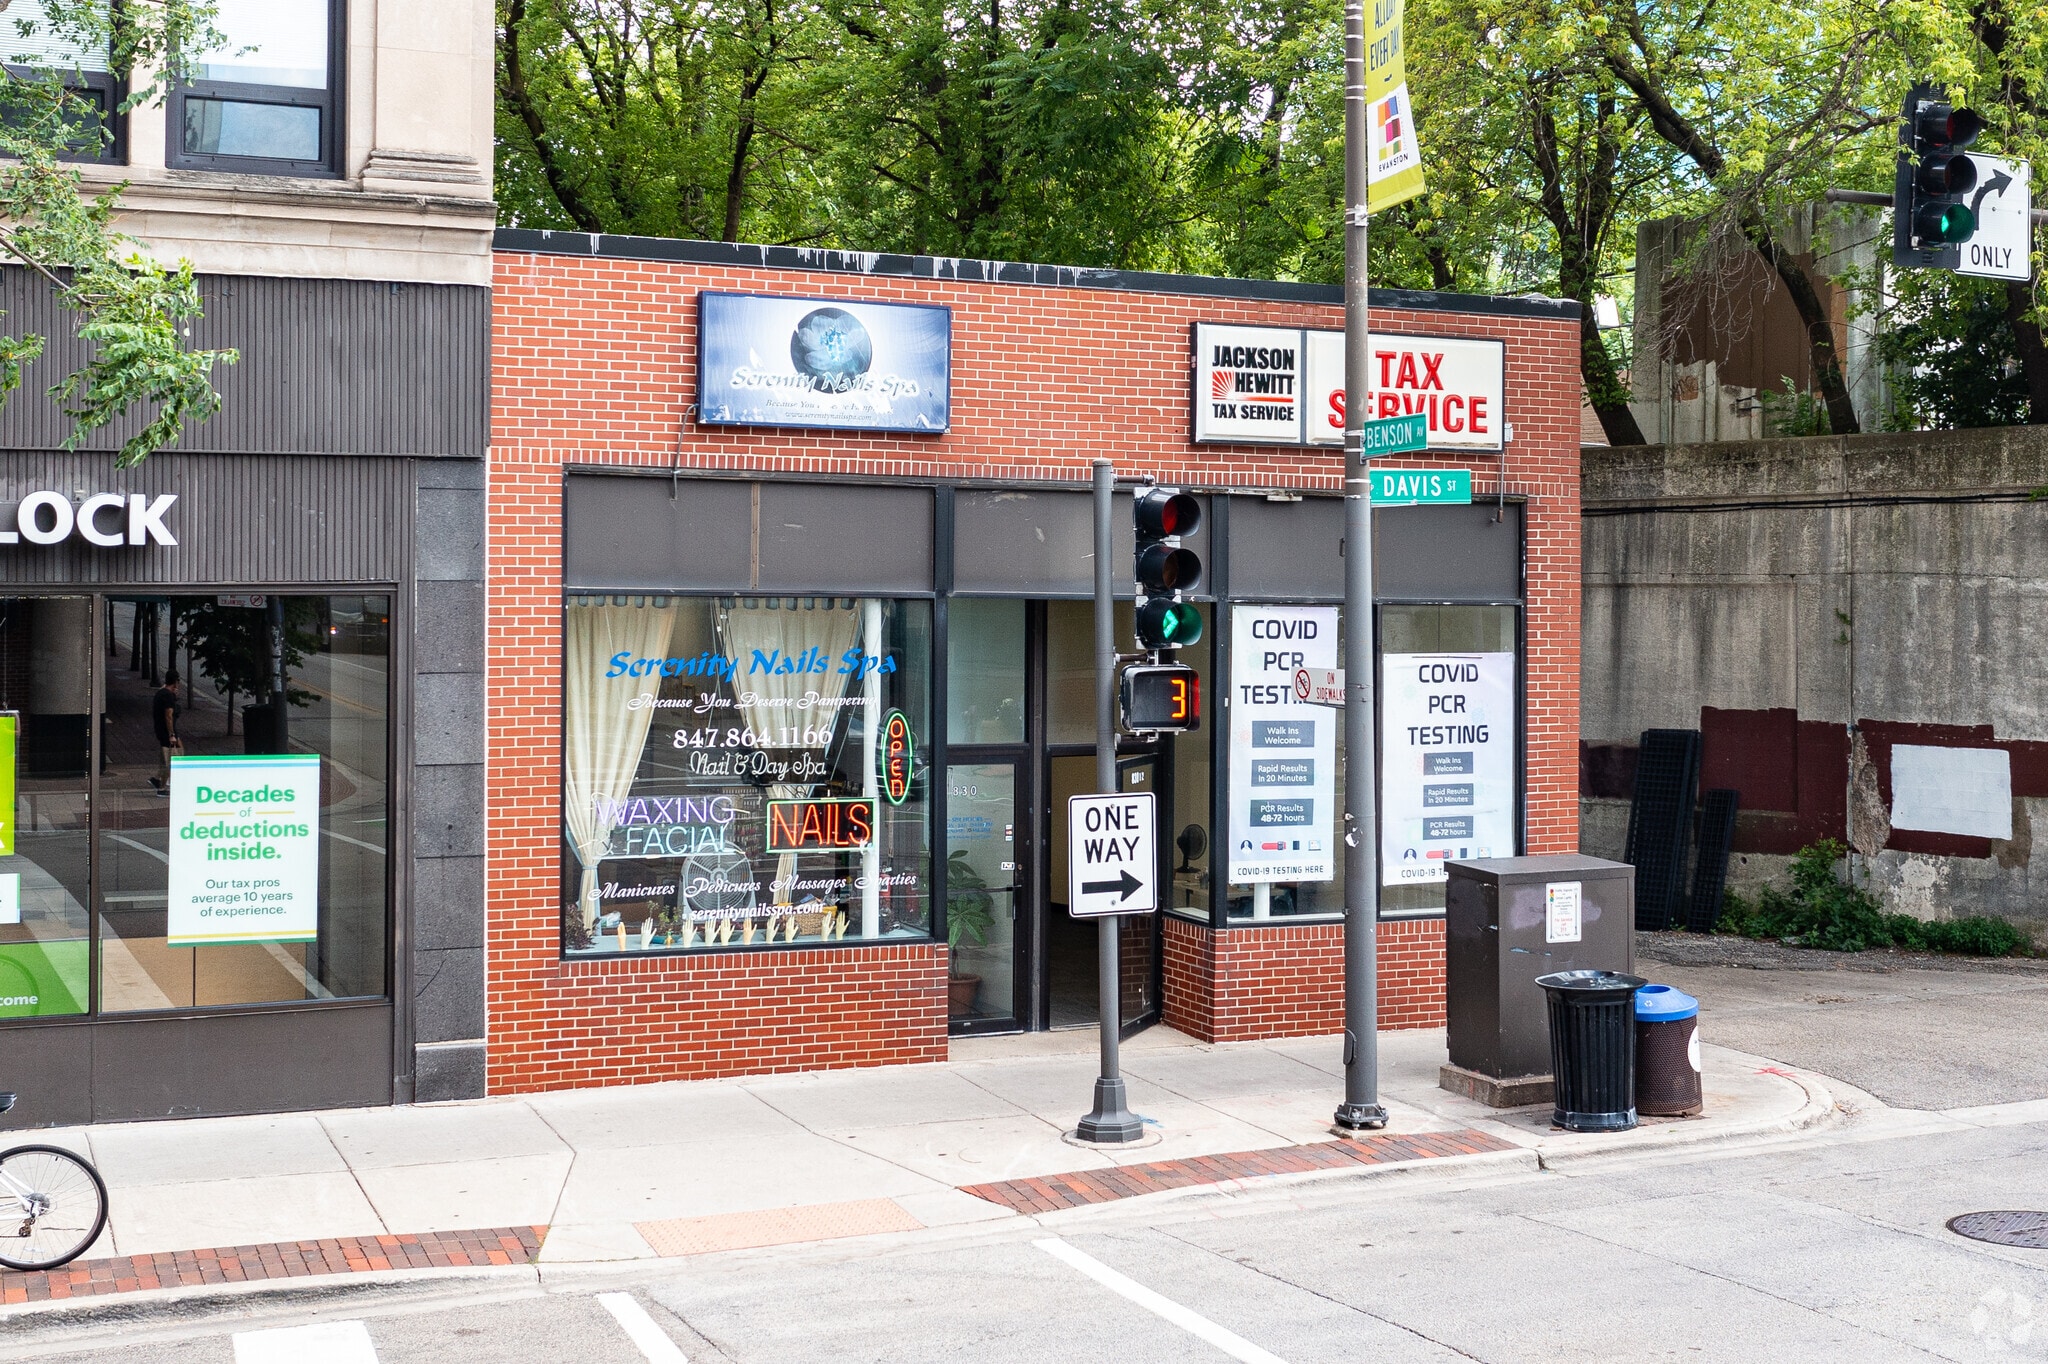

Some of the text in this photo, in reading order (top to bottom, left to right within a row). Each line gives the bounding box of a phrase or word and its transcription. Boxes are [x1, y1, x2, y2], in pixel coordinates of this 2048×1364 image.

[1379, 153, 1409, 172] EVANSTON
[1970, 244, 2012, 268] ONLY
[1212, 345, 1295, 370] JACKSON
[1375, 350, 1444, 391] TAX
[732, 367, 919, 397] Serenity Nails Spa
[1235, 371, 1295, 395] HEWITT
[1212, 403, 1295, 422] TAX SERVICE
[1328, 389, 1488, 433] SRVICE
[1367, 421, 1424, 449] BENSON AV
[1383, 475, 1457, 498] DAVIS ST
[1252, 619, 1318, 640] COVID
[605, 645, 897, 683] Serenity Nails Spa
[1264, 651, 1304, 671] PCR
[1327, 672, 1335, 685] ON
[1418, 663, 1478, 684] COVID
[627, 690, 880, 713] Because You Deserve Pampering
[1171, 679, 1186, 718] 3
[1240, 685, 1303, 704] TEST
[1428, 694, 1466, 714] PCR
[673, 723, 833, 749] 847.864.1166
[1265, 735, 1302, 745] Welcome
[1267, 726, 1300, 736] Walk Ins
[1407, 724, 1489, 746] TESTING
[690, 750, 827, 779] Nail & Day Spa
[890, 719, 905, 797] OPEN
[1436, 756, 1461, 765] Walk Ins
[1258, 764, 1308, 775] Rapid Results
[1258, 773, 1307, 783] In 20 Minutes
[1433, 764, 1463, 773] Welcome
[196, 784, 296, 804] Decades
[952, 785, 977, 796] 830
[1428, 786, 1469, 797] Rapid Results
[1445, 795, 1468, 804] Minutes
[239, 807, 253, 818] of
[596, 796, 735, 826] WAXING
[1260, 803, 1304, 813] PCR Results
[1260, 813, 1305, 823] 48-72 hours
[772, 803, 871, 847] NAILS
[1085, 805, 1139, 832] ONE
[1430, 819, 1466, 829] PCR Results
[180, 820, 309, 840] deductions
[626, 825, 737, 855] FACIAL
[1430, 827, 1467, 837] 48-72 hours
[207, 842, 282, 861] inside.
[1085, 836, 1140, 863] WAY
[1237, 864, 1324, 876] COVID-19 TESTING HERE
[1401, 868, 1436, 878] COVID-19
[205, 879, 280, 890] Our tax pros
[587, 882, 676, 902] Manicures
[684, 877, 762, 898] Pedicures
[769, 874, 846, 897] Massages
[191, 891, 293, 905] average 10 years
[200, 905, 287, 918] of experience.
[691, 902, 824, 921] serenitynailsspa.com
